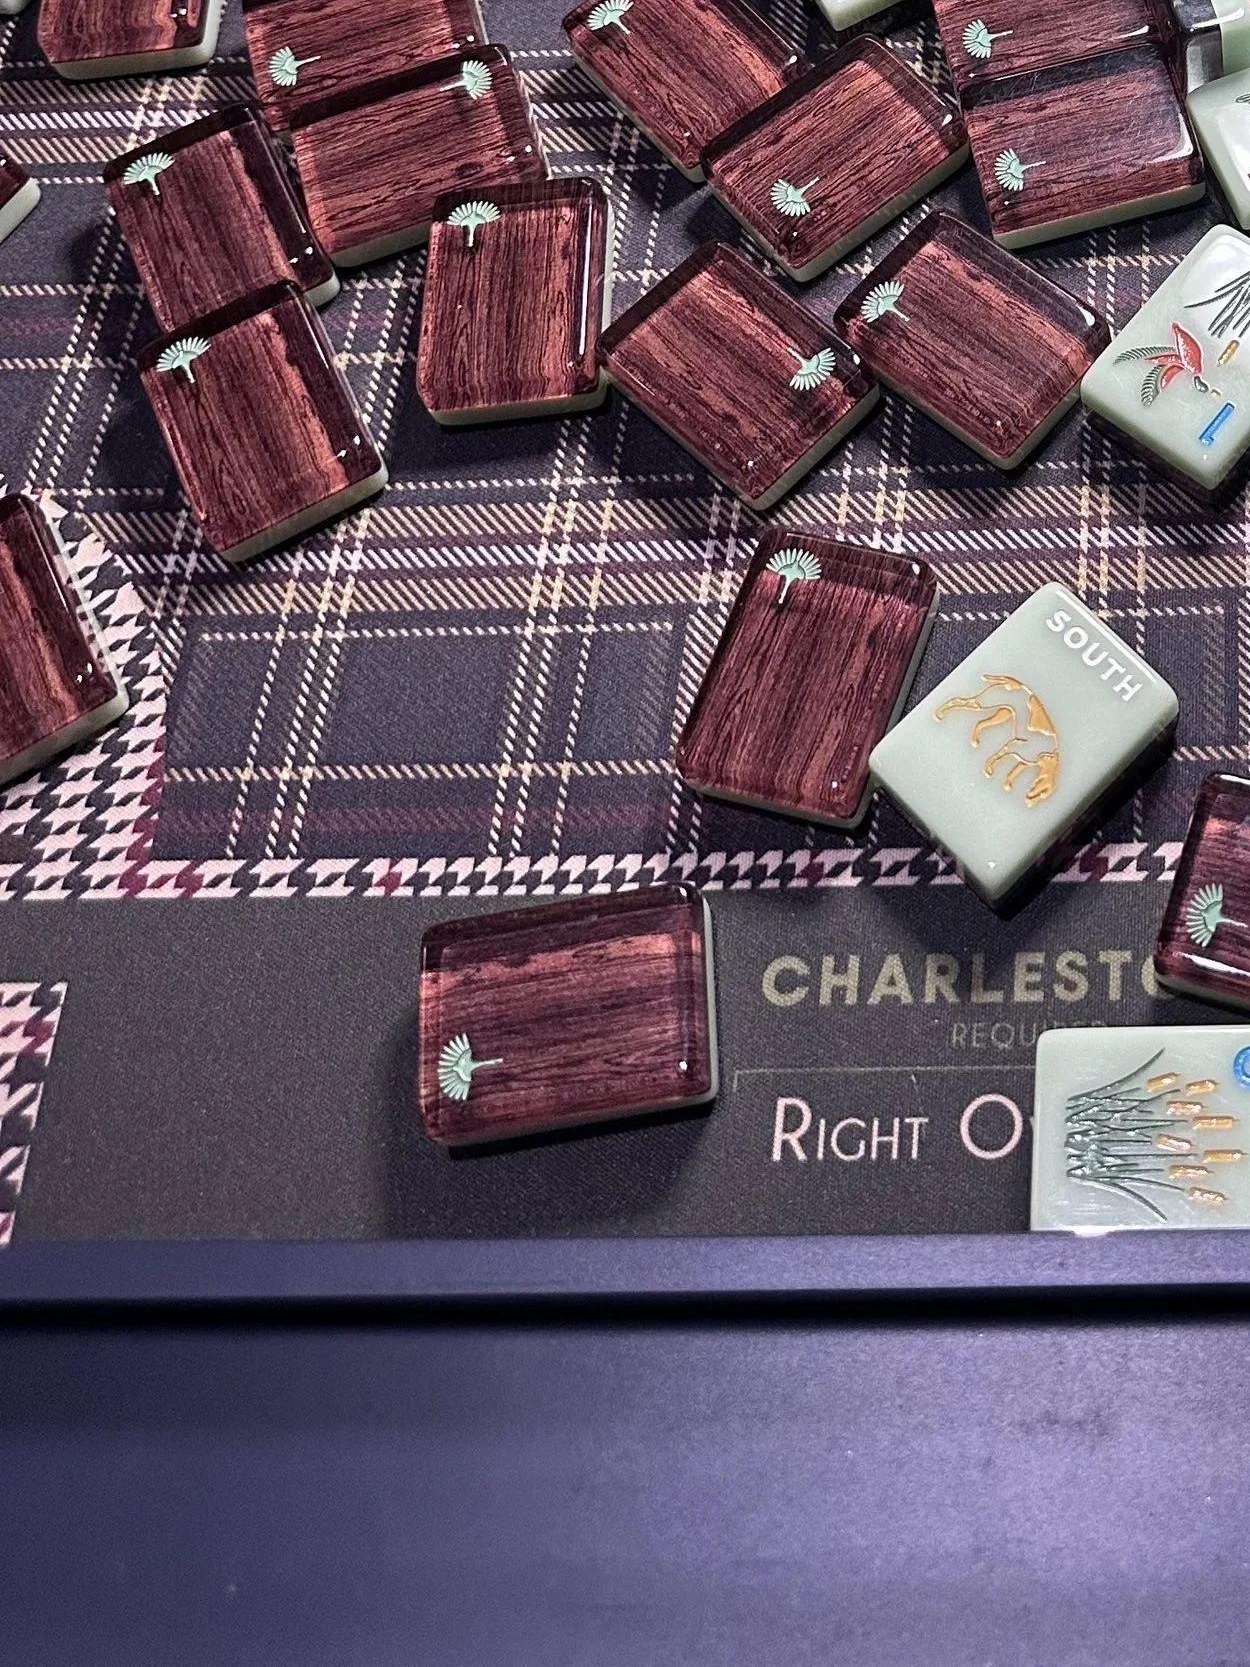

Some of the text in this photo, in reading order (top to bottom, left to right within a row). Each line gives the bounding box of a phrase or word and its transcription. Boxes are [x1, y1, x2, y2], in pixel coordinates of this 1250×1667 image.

[1199, 400, 1236, 447] 1
[1044, 607, 1147, 703] SOUTH
[771, 1095, 929, 1164] RIGHT
